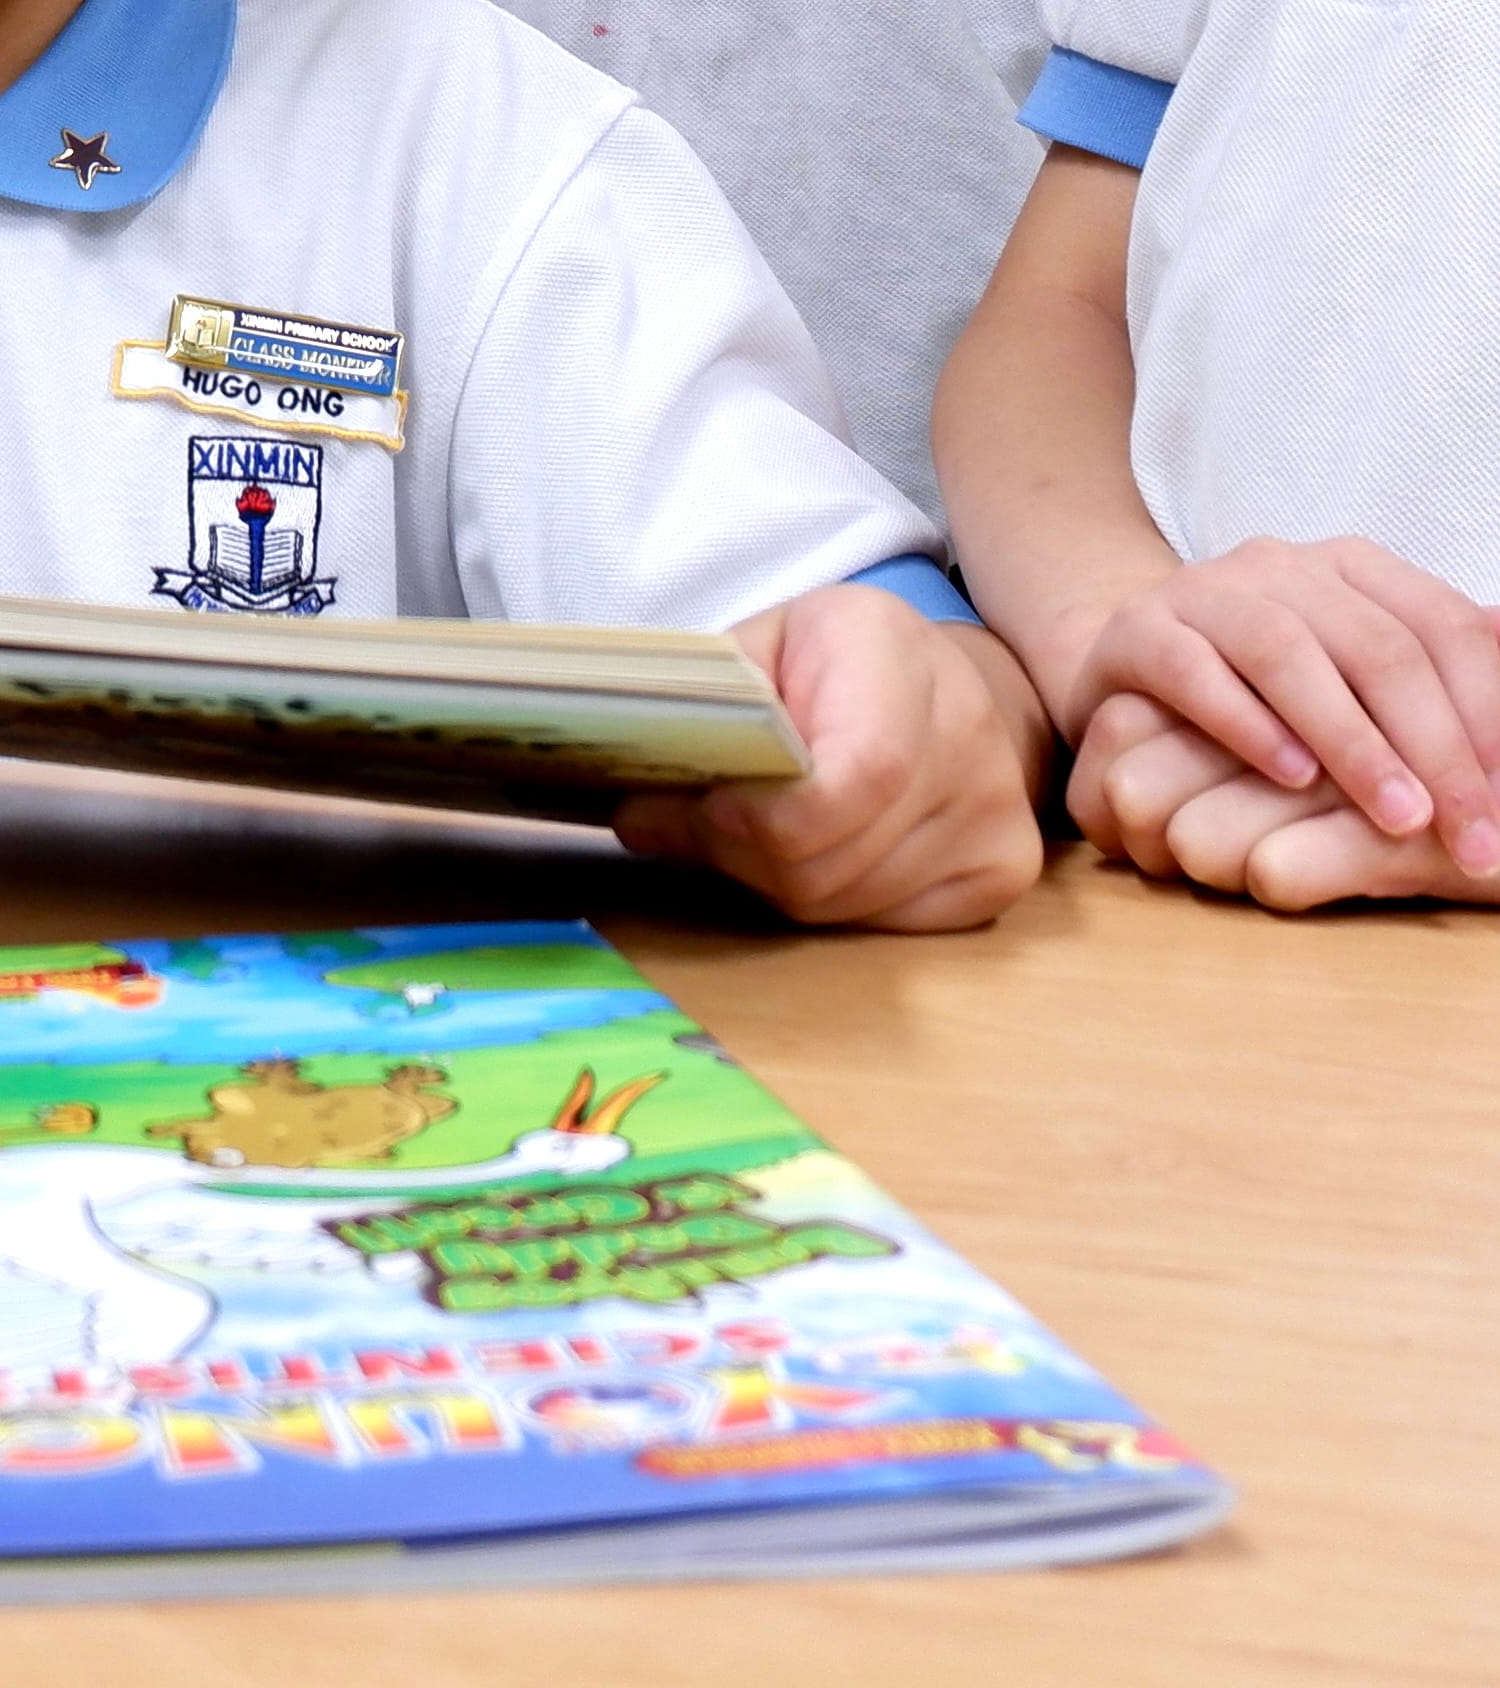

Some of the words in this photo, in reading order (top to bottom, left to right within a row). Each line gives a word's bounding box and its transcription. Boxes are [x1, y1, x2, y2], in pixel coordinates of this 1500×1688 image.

[240, 312, 285, 334] XINMIN
[285, 321, 340, 345] PRIMARY
[341, 330, 393, 353] SCHOOL
[233, 337, 295, 371] CLASS
[182, 368, 262, 406] HUGO
[277, 387, 345, 418] ONG
[193, 441, 316, 485] XINMIN
